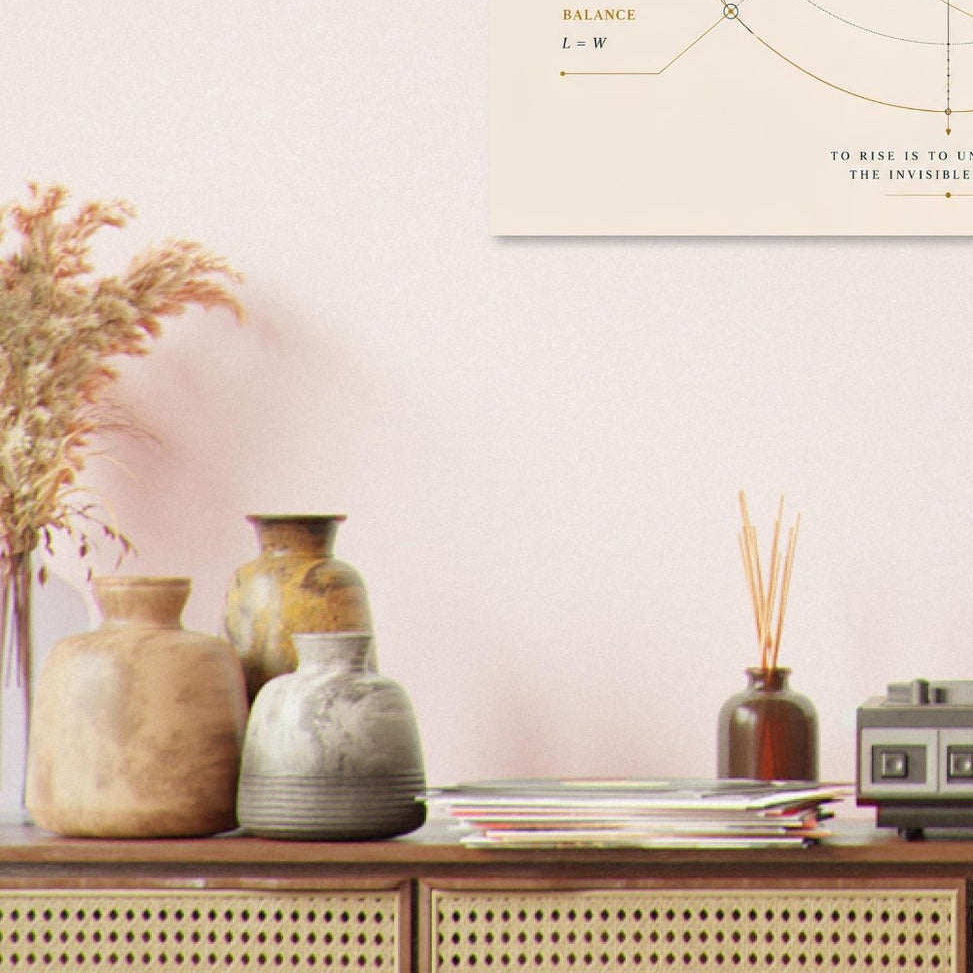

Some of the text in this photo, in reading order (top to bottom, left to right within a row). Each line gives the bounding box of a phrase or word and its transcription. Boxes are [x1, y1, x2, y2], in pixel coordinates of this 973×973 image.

[562, 8, 636, 21] BALANCE
[830, 150, 851, 162] TO
[859, 150, 896, 162] RISE
[904, 150, 919, 162] IS
[927, 150, 948, 162] TO
[849, 169, 880, 180] THE
[889, 169, 970, 180] INVISIBLE
